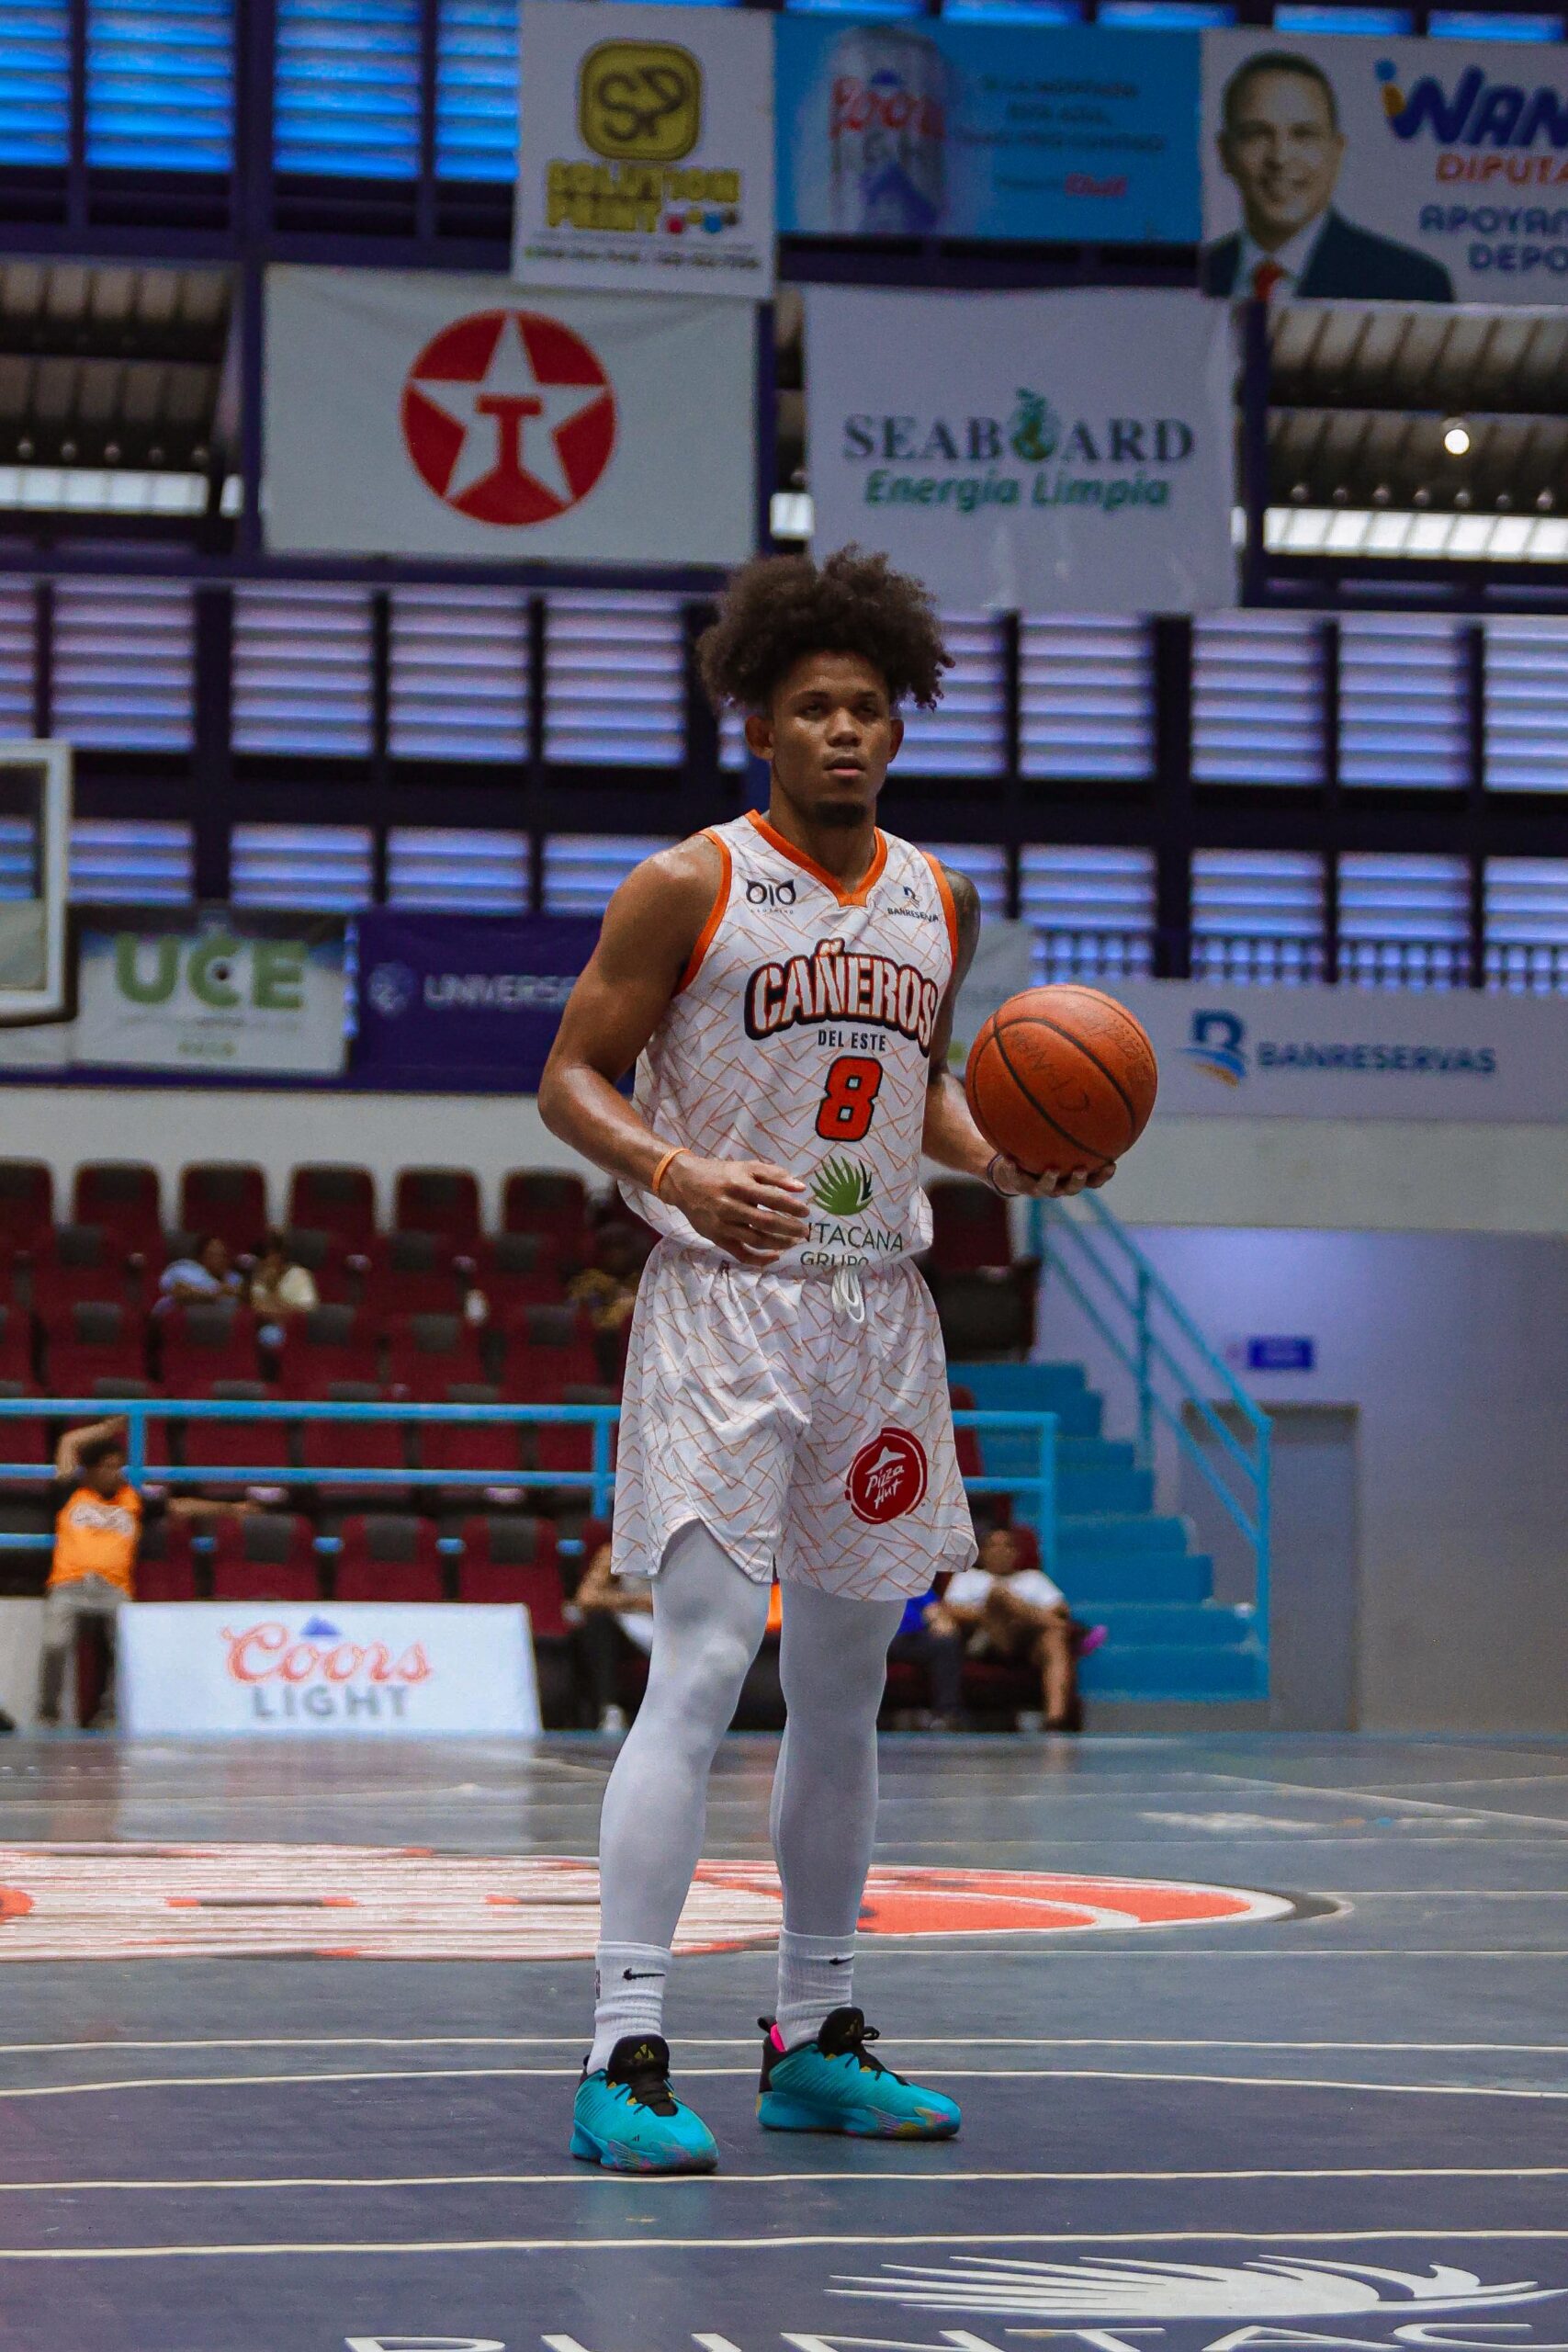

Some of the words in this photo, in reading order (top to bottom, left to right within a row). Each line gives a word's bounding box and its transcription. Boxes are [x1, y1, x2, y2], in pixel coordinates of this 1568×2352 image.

[1468, 243, 1568, 274] DEPO
[114, 931, 308, 1009] UCE
[744, 937, 939, 1057] CAÑEROS
[818, 1028, 844, 1048] DEL
[851, 1031, 886, 1052] ESTE
[814, 1056, 883, 1142] 8
[864, 1464, 905, 1499] Pizza
[874, 1478, 903, 1510] Hut
[220, 1621, 433, 1683] Coors
[251, 1685, 412, 1719] LIGHT
